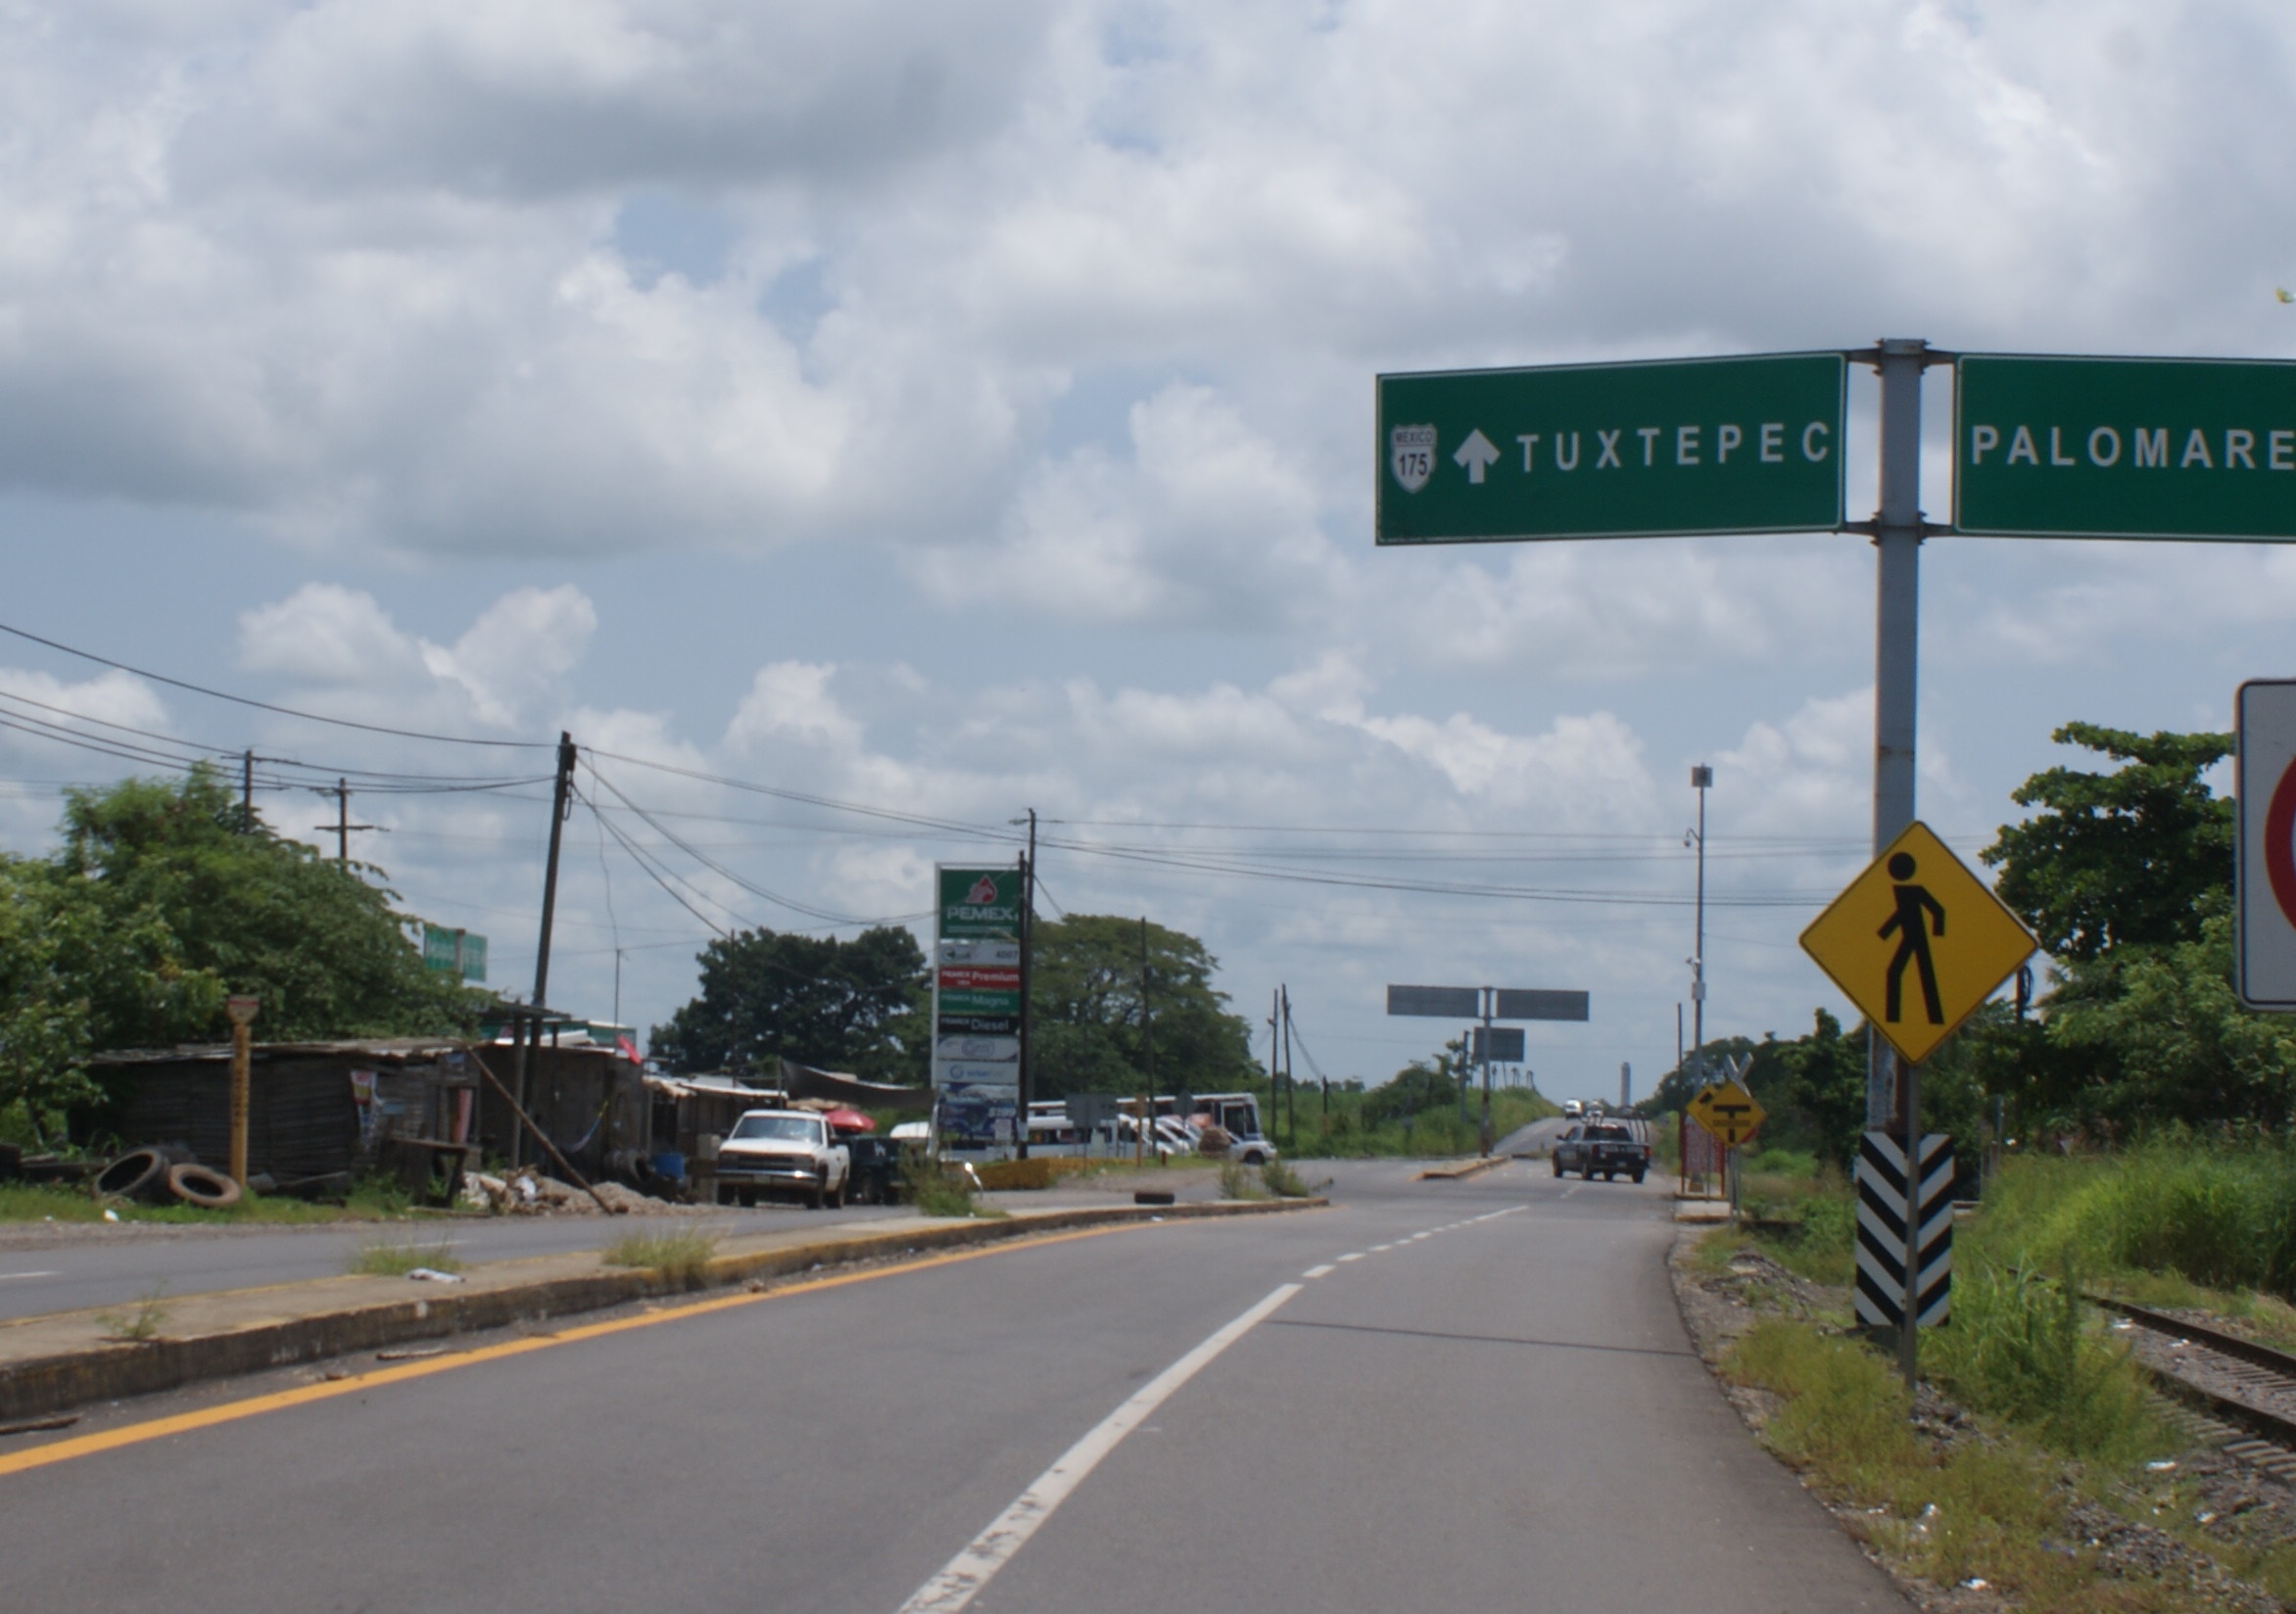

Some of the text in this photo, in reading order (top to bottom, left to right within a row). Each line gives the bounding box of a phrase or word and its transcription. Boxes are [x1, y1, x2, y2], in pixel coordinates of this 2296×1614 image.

[1516, 421, 1830, 473] TUXTEPEC
[1970, 424, 2296, 470] PALOMARE
[1399, 452, 1428, 476] 175
[946, 905, 1013, 921] PEMEX
[972, 970, 1020, 982] Premium
[972, 995, 1010, 1009] Magna
[971, 1018, 1010, 1030] Diesel
